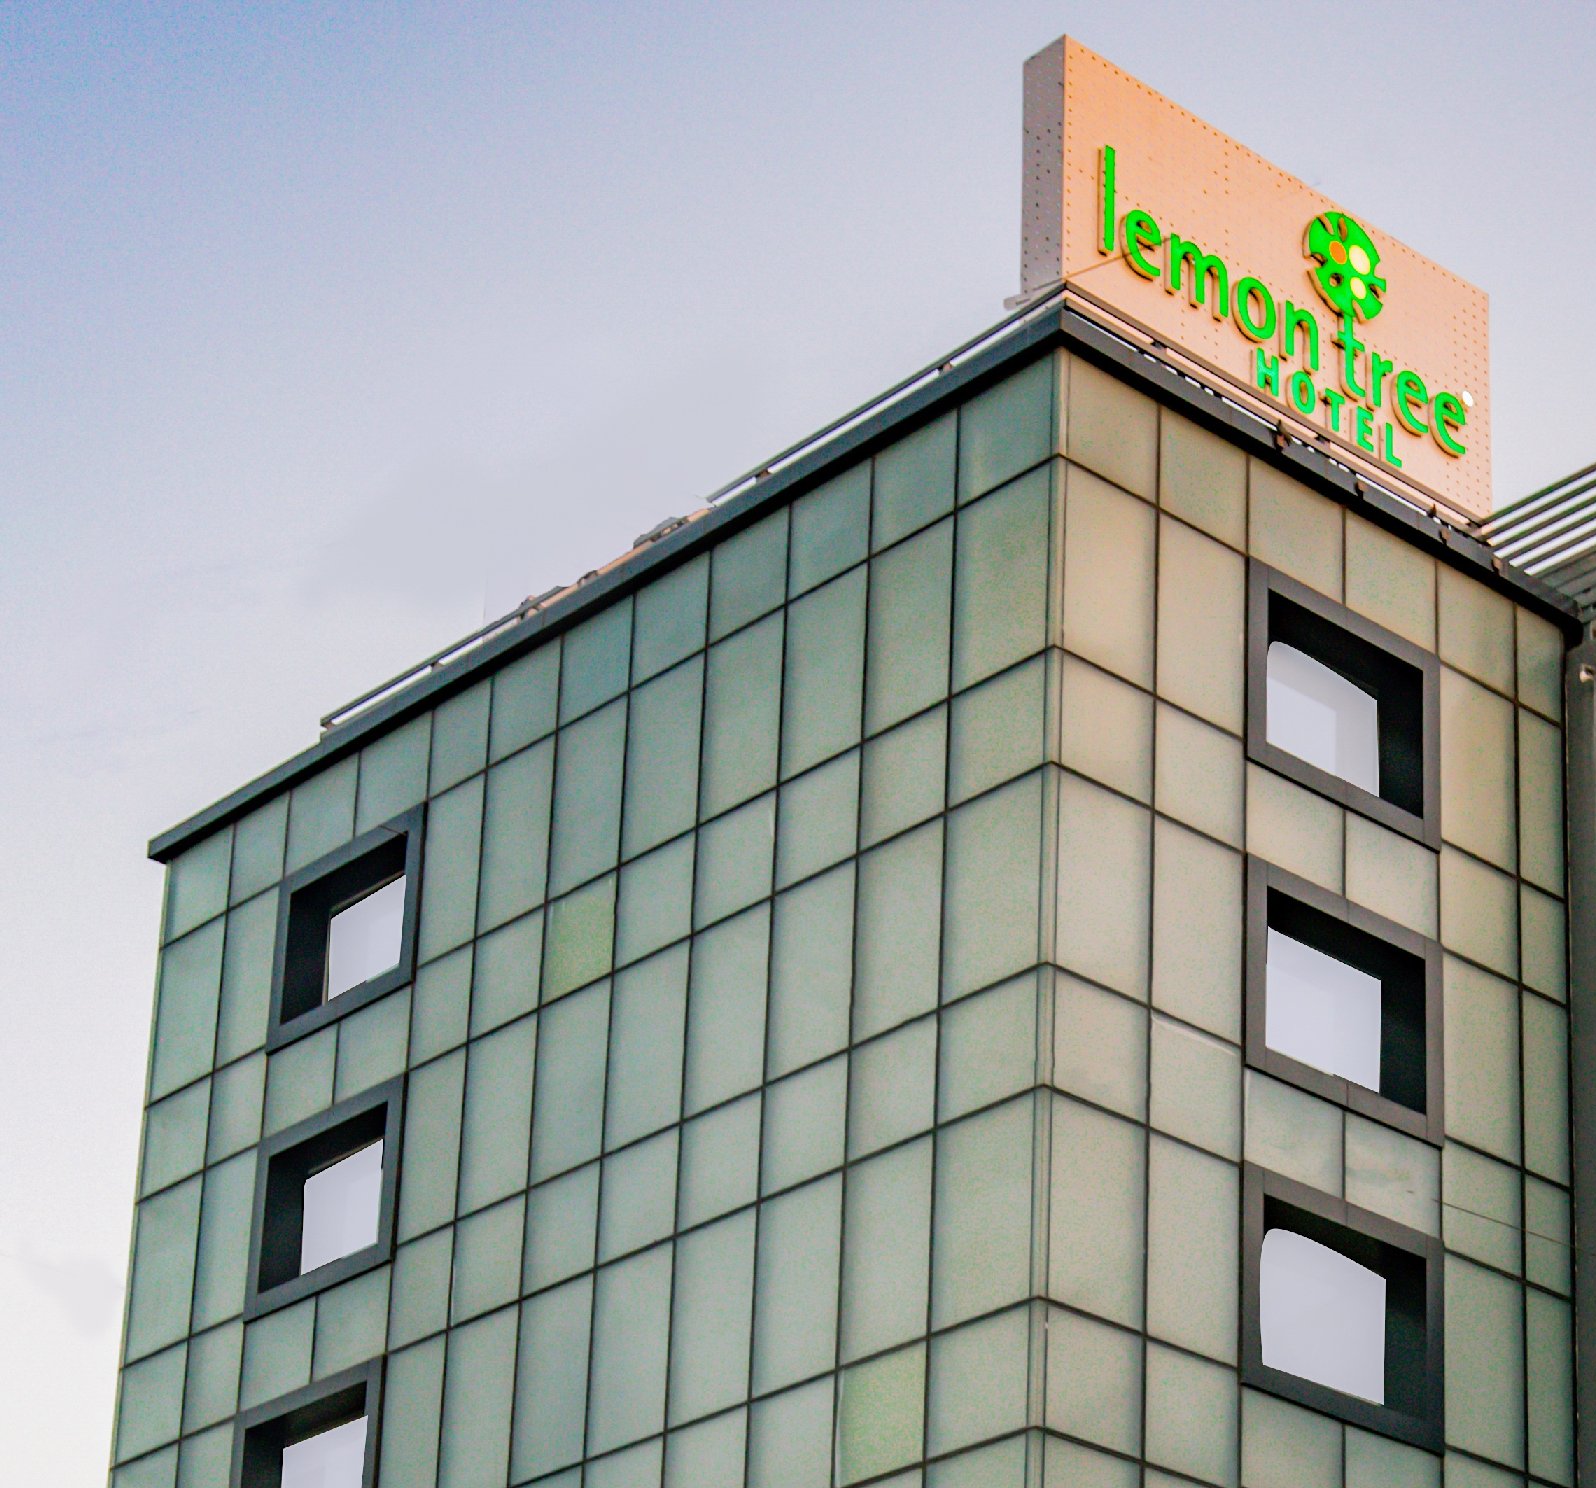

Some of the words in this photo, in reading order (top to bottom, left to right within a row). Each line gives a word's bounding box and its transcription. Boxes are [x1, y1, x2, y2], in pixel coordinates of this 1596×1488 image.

[1098, 144, 1320, 374] lemon
[1332, 315, 1467, 457] tree
[1253, 347, 1403, 468] HOTEL
